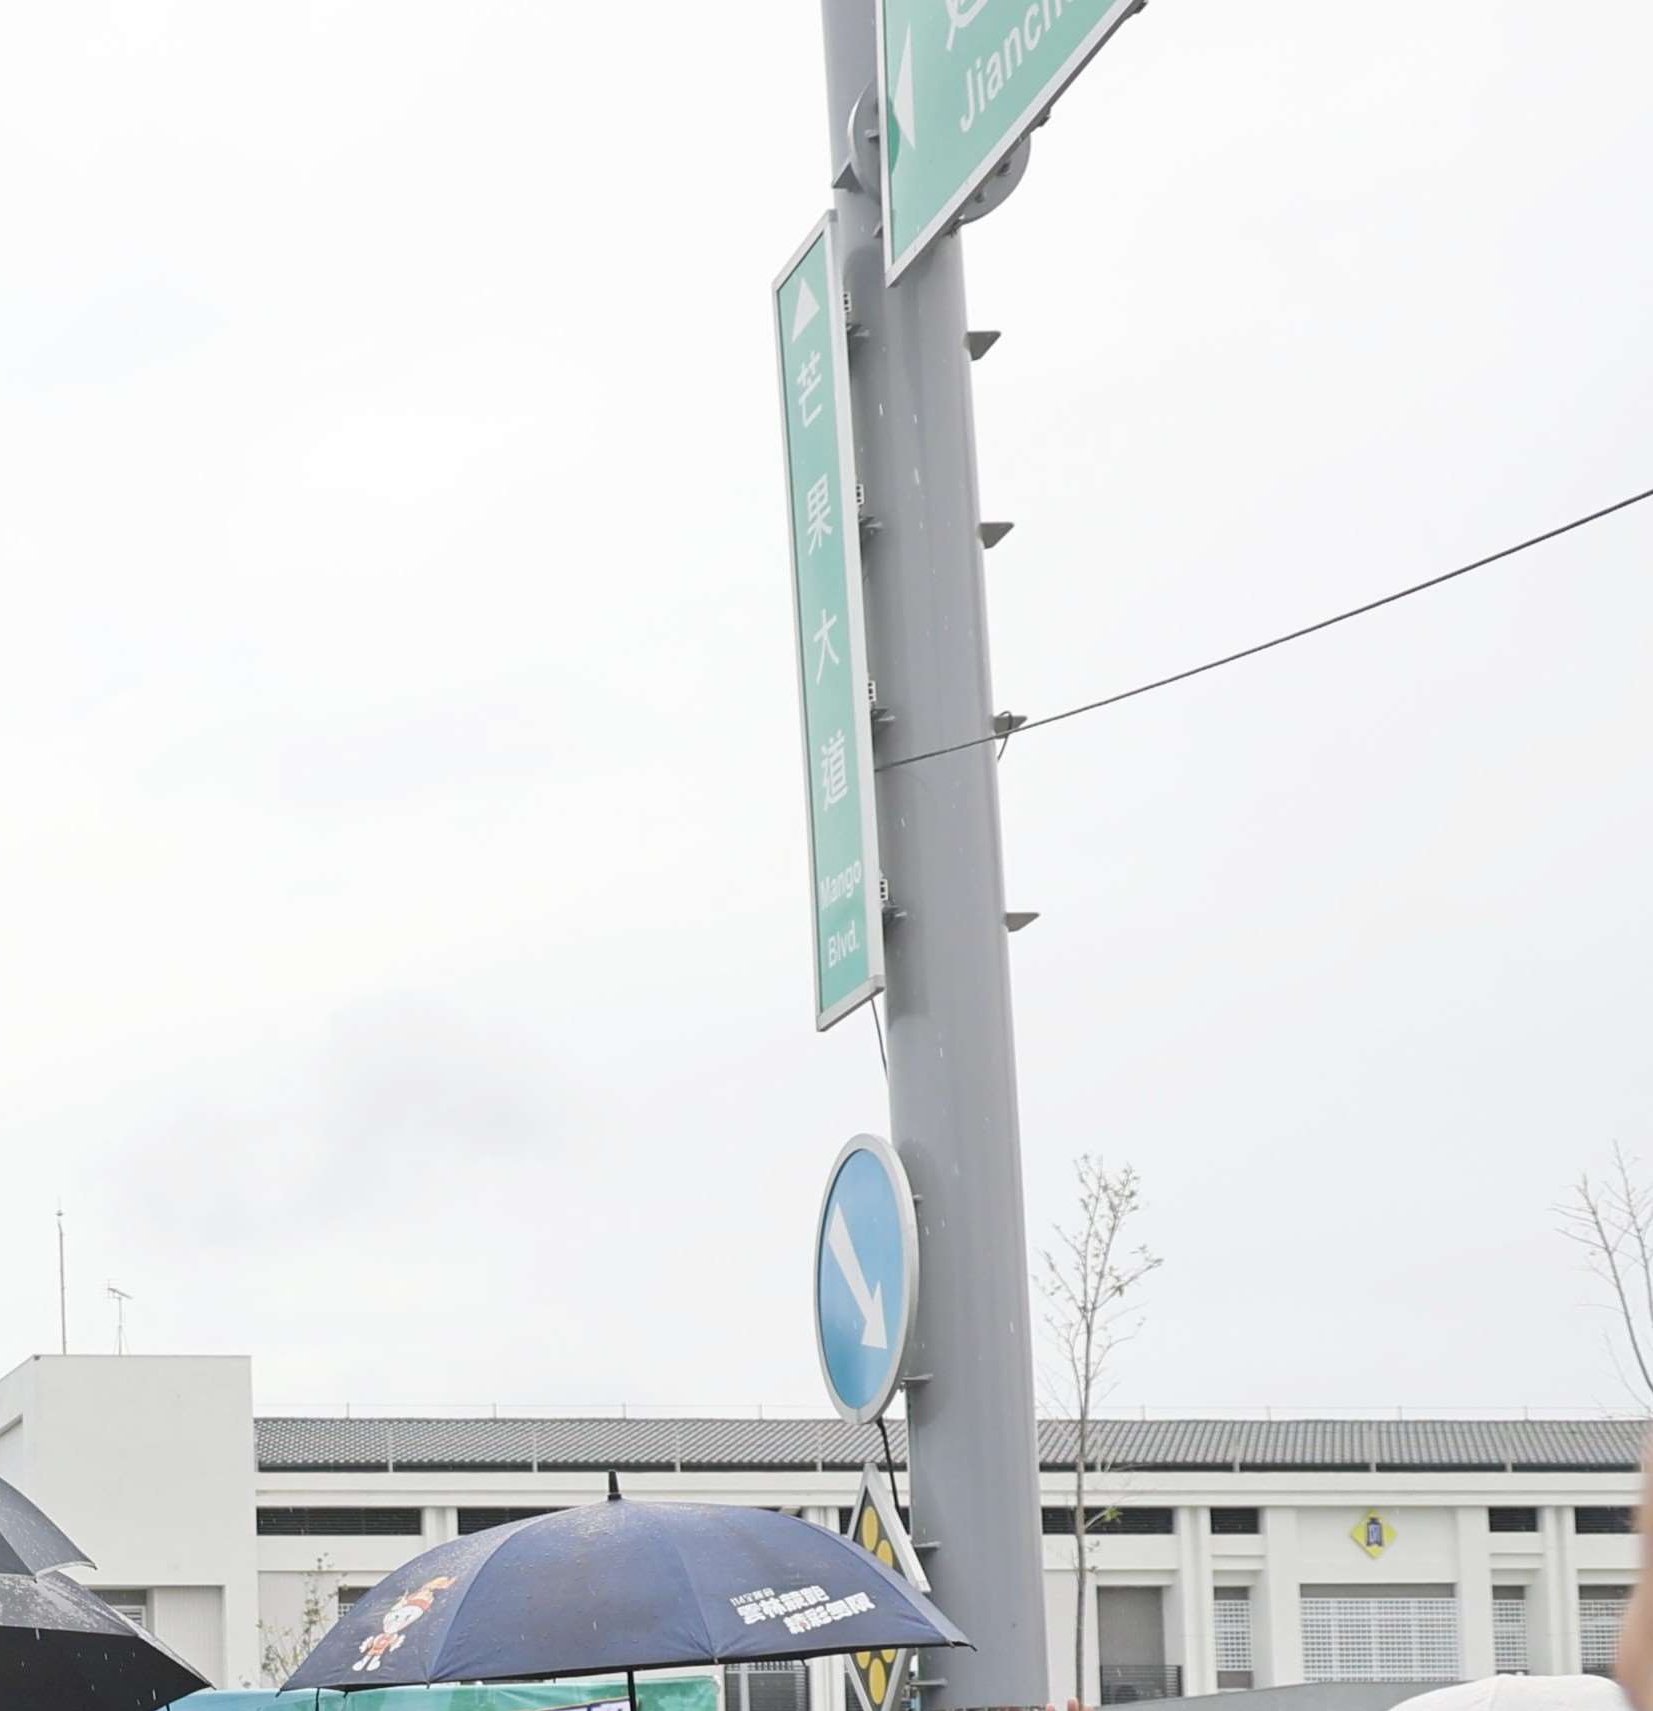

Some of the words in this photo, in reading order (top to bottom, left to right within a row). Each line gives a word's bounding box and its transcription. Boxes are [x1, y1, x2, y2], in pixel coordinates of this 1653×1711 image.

[796, 350, 849, 812] 芒果大道
[820, 860, 862, 911] Mango
